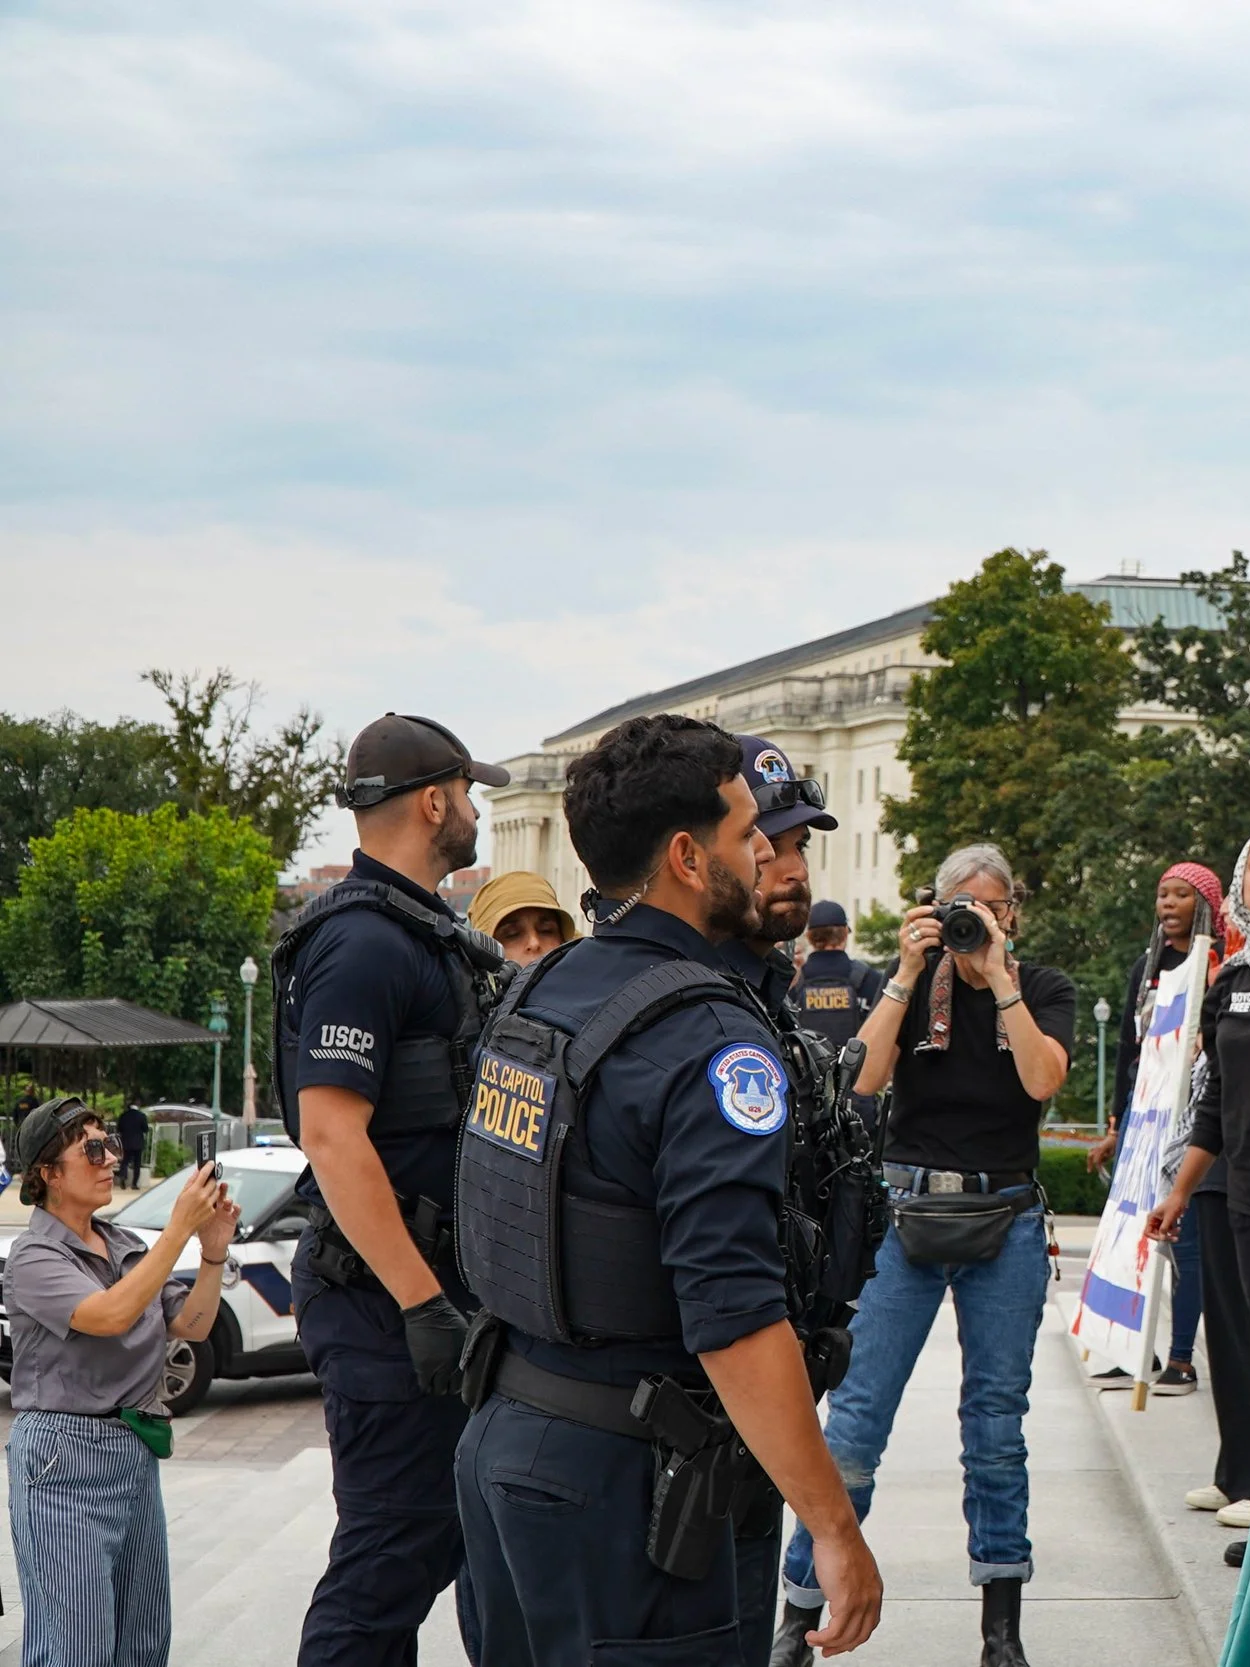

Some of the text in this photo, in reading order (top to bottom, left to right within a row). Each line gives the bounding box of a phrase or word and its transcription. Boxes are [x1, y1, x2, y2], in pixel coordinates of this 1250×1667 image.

[805, 995, 851, 1009] POLICE
[1229, 1002, 1250, 1013] FREE
[320, 1024, 376, 1054] USCP
[730, 1050, 749, 1062] STATES
[481, 1057, 546, 1106] U.S. CAPITOL
[471, 1082, 545, 1152] POLICE
